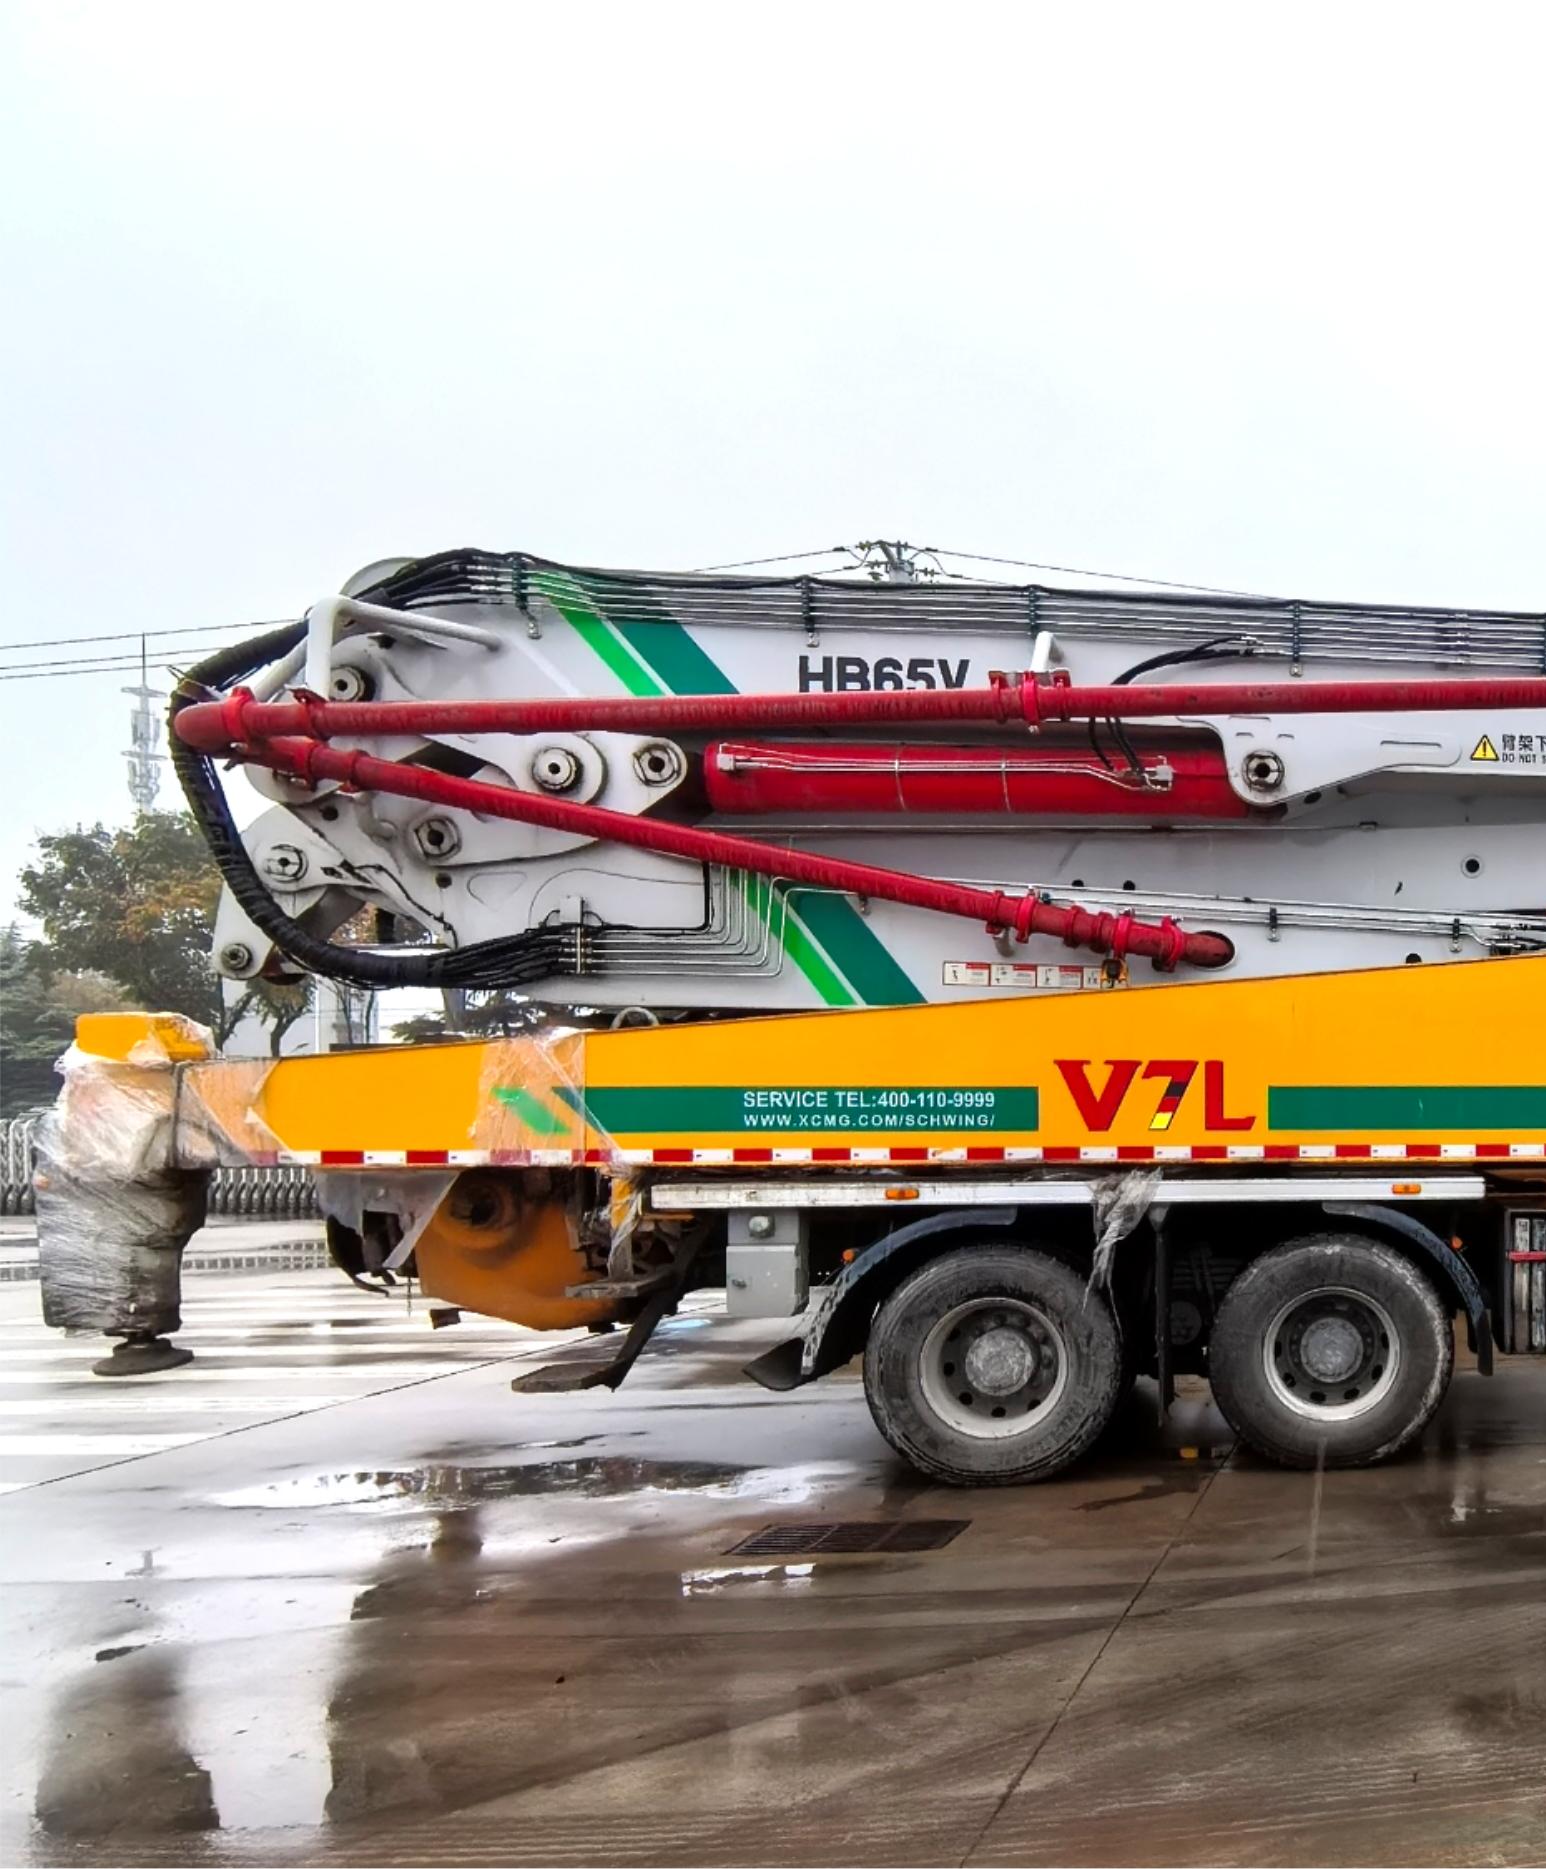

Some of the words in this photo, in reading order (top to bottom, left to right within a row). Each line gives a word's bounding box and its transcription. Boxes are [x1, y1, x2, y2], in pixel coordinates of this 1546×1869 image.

[799, 655, 970, 693] HB65V
[1502, 753, 1515, 763] DO
[1519, 753, 1536, 764] NOT
[743, 1091, 828, 1108] SERVICE
[834, 1091, 996, 1109] TEL:400-110-9999
[1053, 1059, 1257, 1132] V7L
[743, 1113, 996, 1128] WWW.XCMG.COM/SCHWING/
